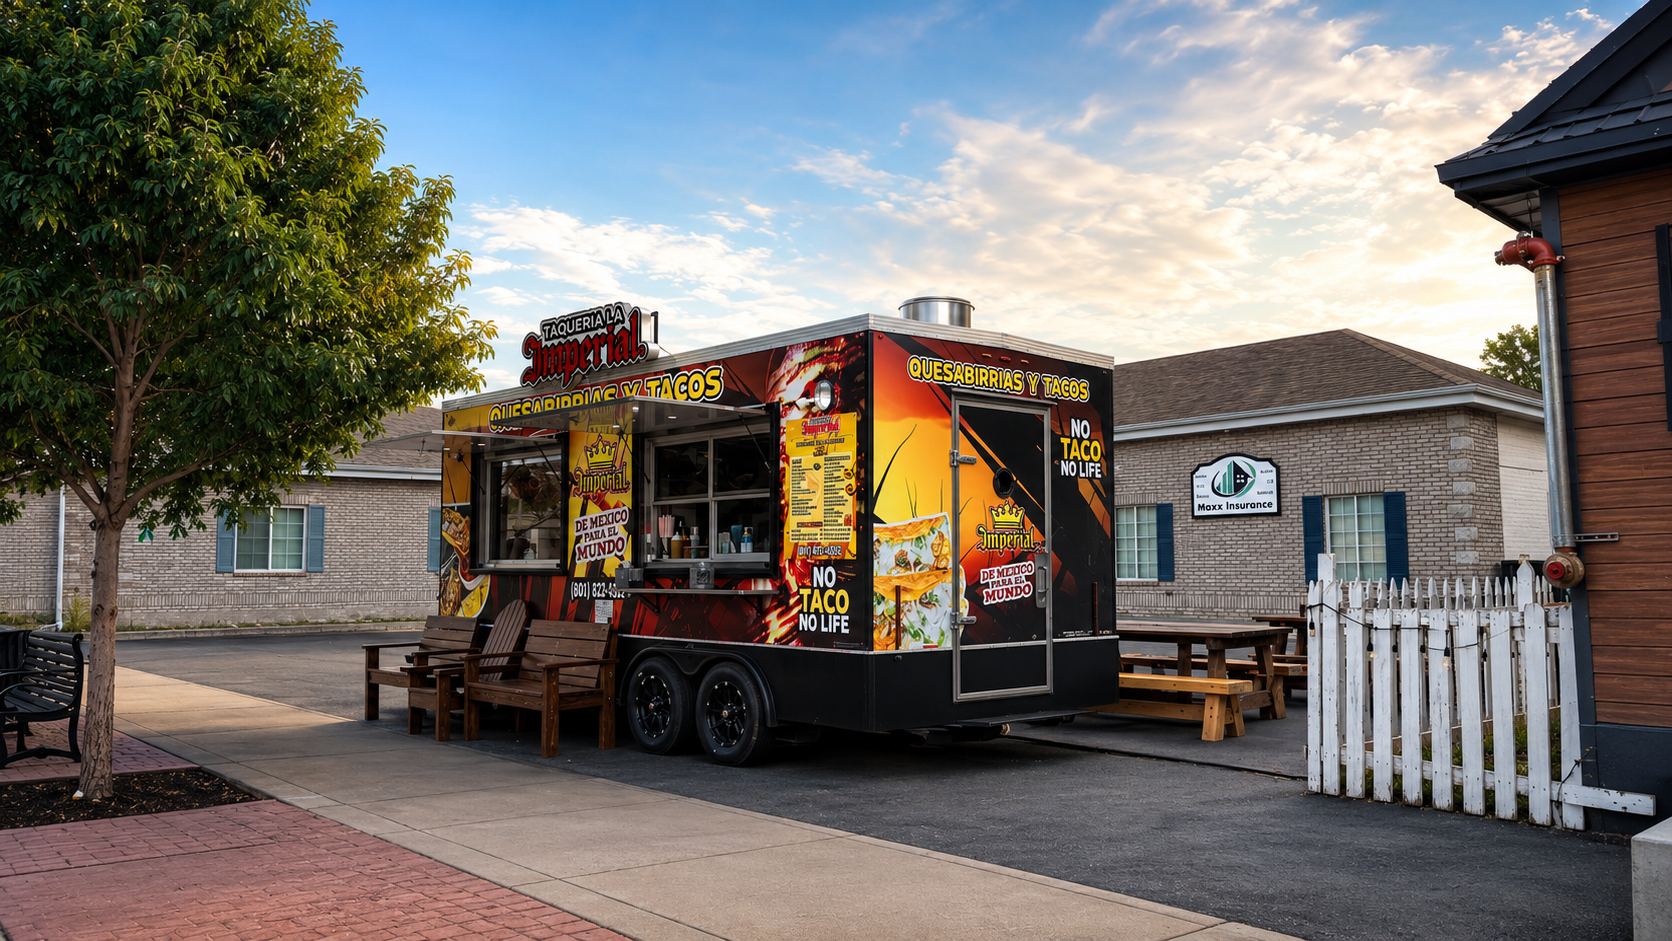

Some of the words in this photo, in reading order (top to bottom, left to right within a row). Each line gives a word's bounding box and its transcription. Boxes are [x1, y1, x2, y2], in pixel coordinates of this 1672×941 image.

[543, 313, 604, 339] TAQUERIA
[606, 307, 623, 325] LA
[522, 311, 646, 387] Imperial
[646, 367, 723, 401] TACOS
[908, 356, 1024, 392] QUESABIRRIAS
[1026, 371, 1041, 396] Y
[1042, 374, 1090, 401] TACOS
[1070, 418, 1091, 439] NO
[1060, 437, 1102, 462] TACO
[1060, 460, 1077, 477] NO
[1079, 461, 1102, 478] LIFE
[1226, 501, 1273, 511] Insurance
[575, 518, 589, 533] DE
[589, 509, 628, 530] MEXICO
[608, 526, 619, 537] EL
[576, 536, 626, 562] MUNDO
[976, 524, 1044, 556] Imperial
[813, 565, 837, 588] NO
[981, 569, 996, 582] DE
[991, 578, 1013, 588] PARA
[570, 581, 590, 601] (801)
[799, 588, 850, 614] TACO
[984, 583, 1032, 603] MUNDO
[799, 613, 818, 632] NO
[820, 613, 850, 634] LIFE
